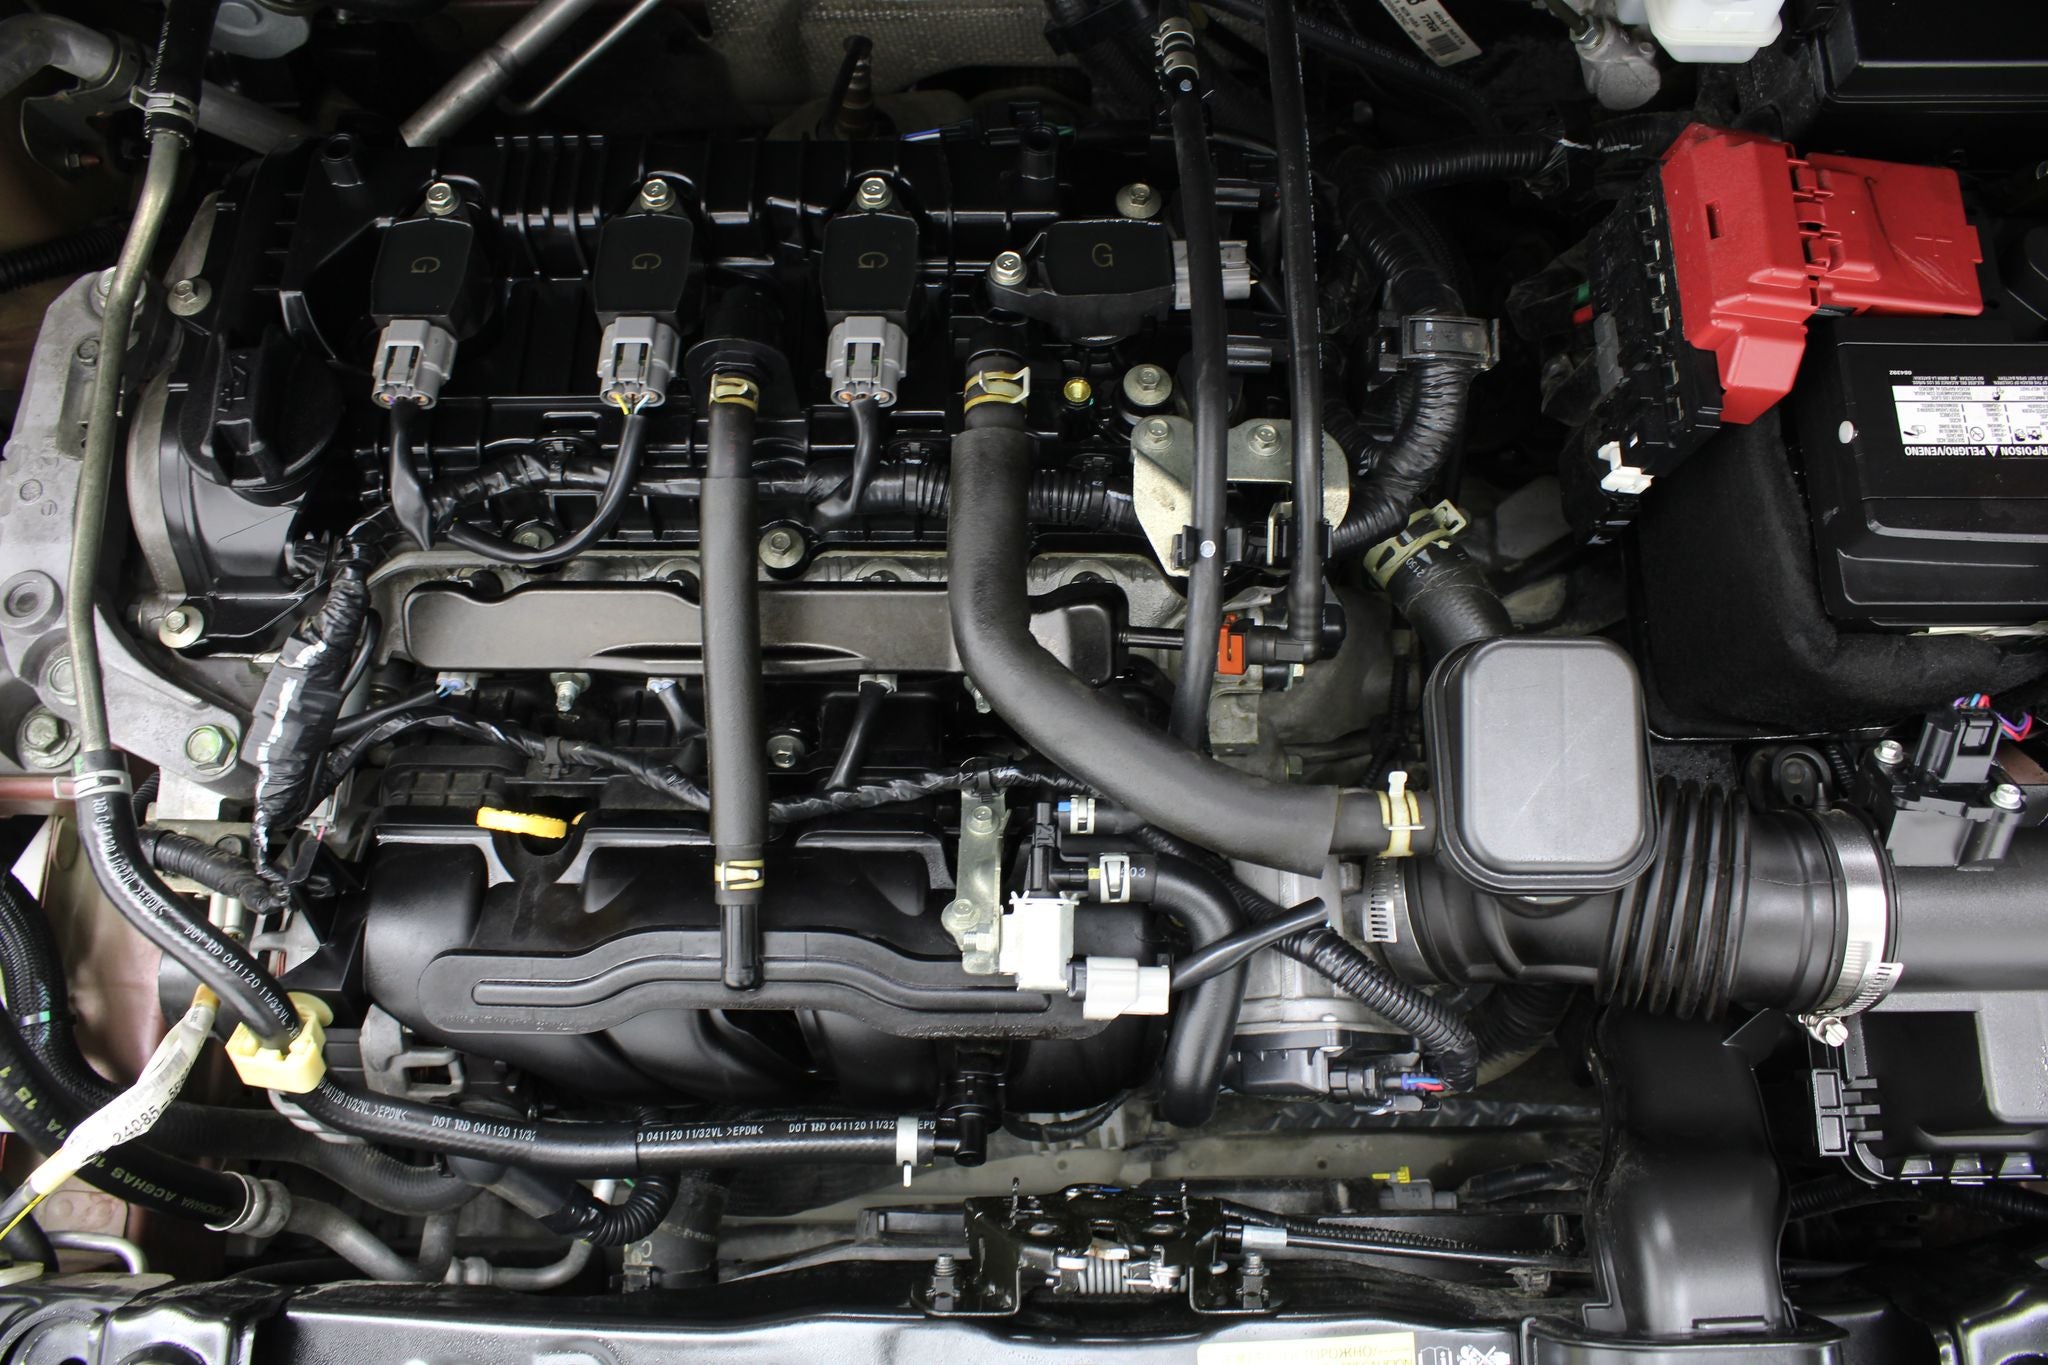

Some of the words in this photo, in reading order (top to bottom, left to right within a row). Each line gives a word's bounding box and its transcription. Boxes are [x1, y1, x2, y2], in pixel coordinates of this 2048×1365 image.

[411, 256, 441, 273] G
[631, 253, 661, 270] G
[858, 251, 889, 270] G
[1092, 243, 1113, 267] G
[1904, 445, 1986, 457] PELIGRO/VENENO
[184, 924, 208, 944] DOT
[222, 953, 262, 989] 041120
[432, 1115, 453, 1129] DOT
[474, 1120, 512, 1137] 041120
[646, 1129, 683, 1143] 041120
[685, 1126, 723, 1141] 11/32VL
[788, 1122, 806, 1134] DOT
[829, 1119, 866, 1132] 041120
